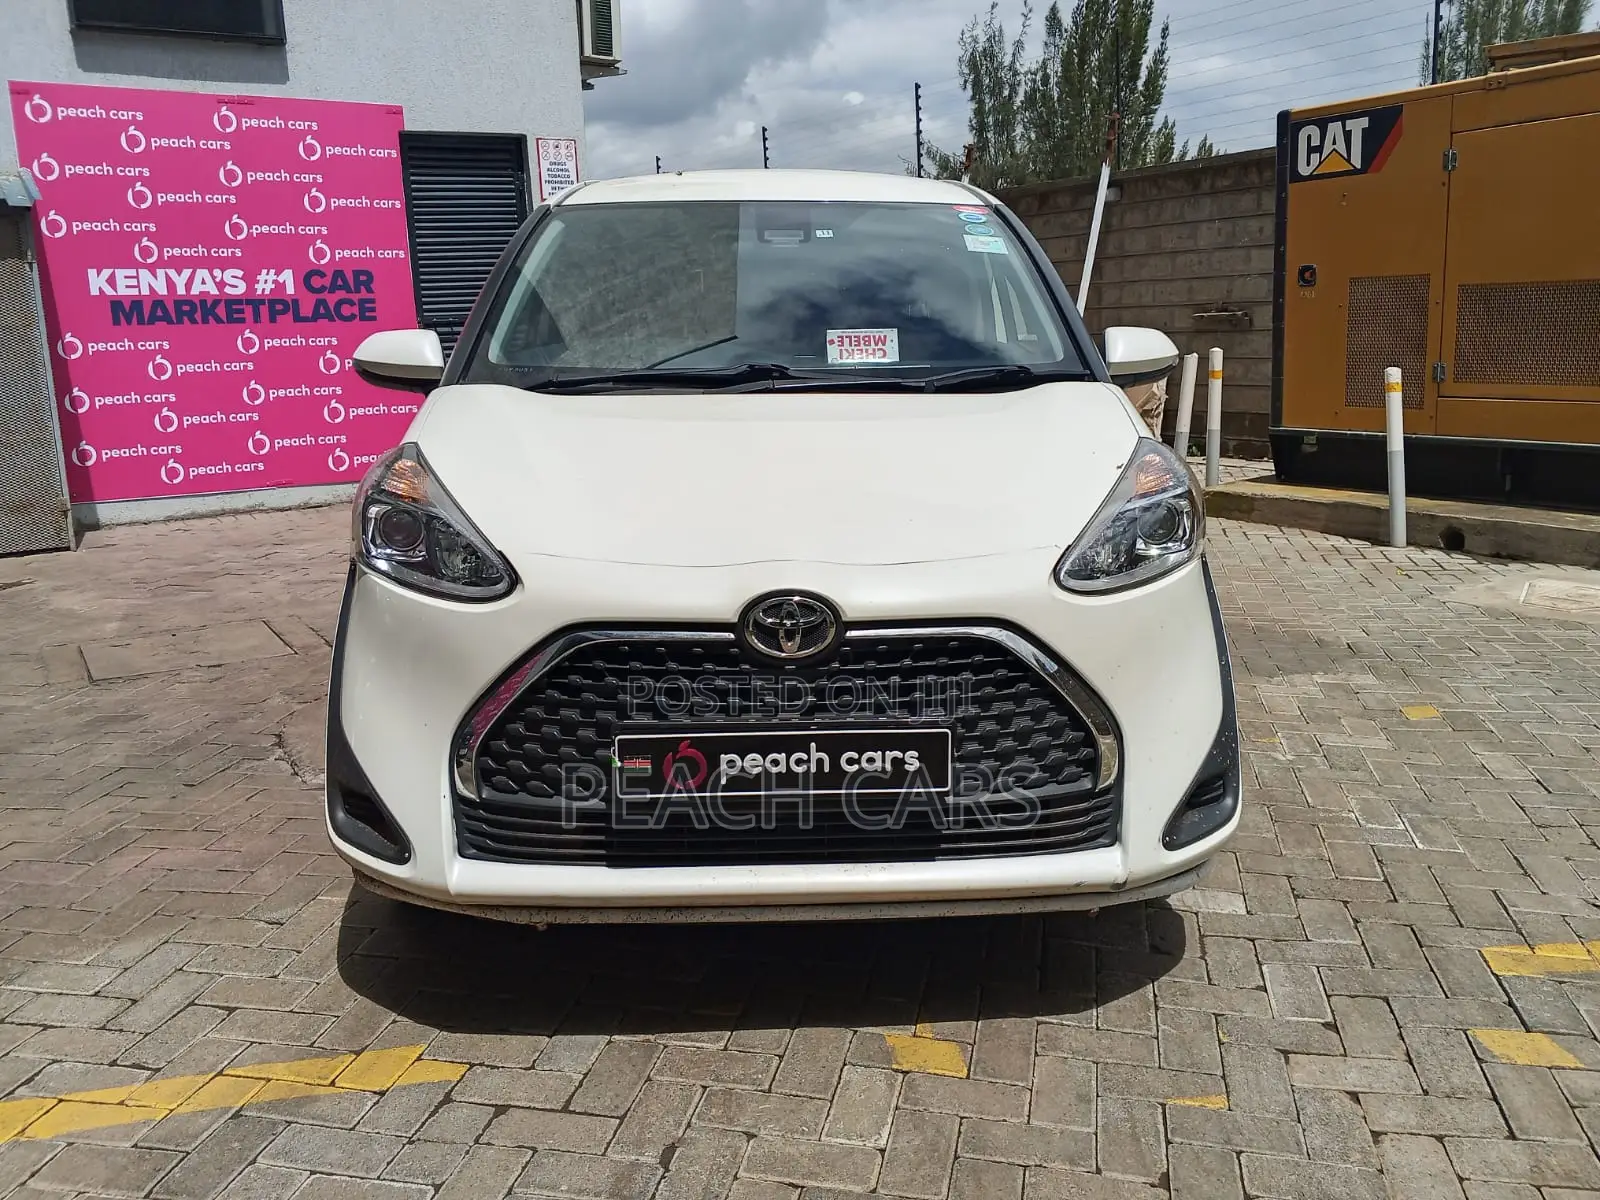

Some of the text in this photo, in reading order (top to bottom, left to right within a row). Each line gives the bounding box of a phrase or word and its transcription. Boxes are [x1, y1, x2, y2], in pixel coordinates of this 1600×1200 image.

[57, 105, 143, 120] peach cars
[242, 116, 318, 130] peach cars
[151, 136, 231, 150] peach cars
[1297, 116, 1369, 176] CAT
[326, 144, 397, 158] peach cars
[65, 162, 150, 178] peach cars
[247, 169, 322, 184] peach cars
[157, 190, 236, 205] peach cars
[331, 196, 401, 210] peach cars
[72, 219, 156, 234] peach cars
[252, 222, 327, 237] peach cars
[164, 244, 241, 260] peach cars
[335, 246, 405, 261] peach cars
[255, 268, 295, 295] #1
[303, 269, 374, 294] CAR
[110, 298, 377, 326] MARKETPLACE
[88, 338, 169, 355] peach cars
[264, 335, 305, 350] peach
[177, 360, 253, 376] peach cars
[95, 392, 176, 408] peach cars
[269, 385, 342, 401] peach cars
[183, 411, 259, 426] peach cars
[350, 403, 419, 419] peach cars
[275, 434, 346, 448] peach cars
[102, 444, 182, 460] peach cars
[190, 462, 264, 477] peach cars
[720, 742, 920, 785] peach cars
